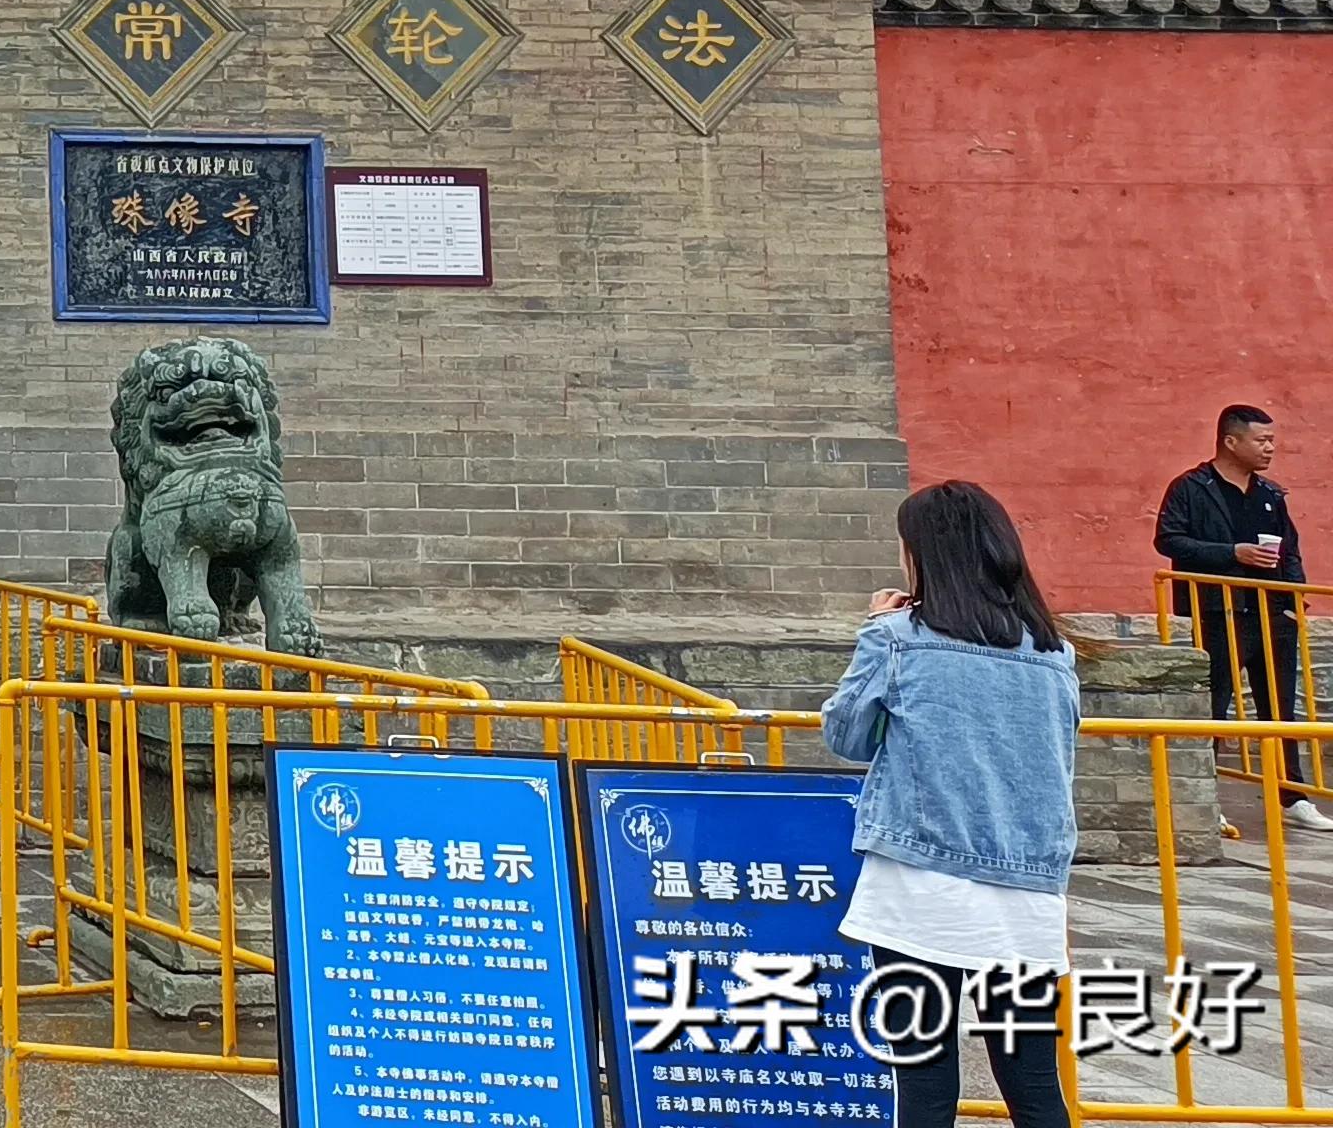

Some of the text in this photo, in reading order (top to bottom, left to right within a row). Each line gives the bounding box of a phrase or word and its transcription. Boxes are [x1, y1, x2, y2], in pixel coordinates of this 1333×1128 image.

[116, 155, 258, 177] 省级重点文物保护单位
[111, 189, 260, 237] 殊像寺
[133, 249, 249, 264] 山西省人民政府
[345, 836, 535, 884] 温馨提示
[650, 859, 837, 903] 温馨提示
[329, 1043, 374, 1059] 的活动。
[652, 1065, 894, 1090] 您遇到以寺庙名义收取一切法务
[656, 1094, 891, 1121] 活动费用的行为均与本寺无关。
